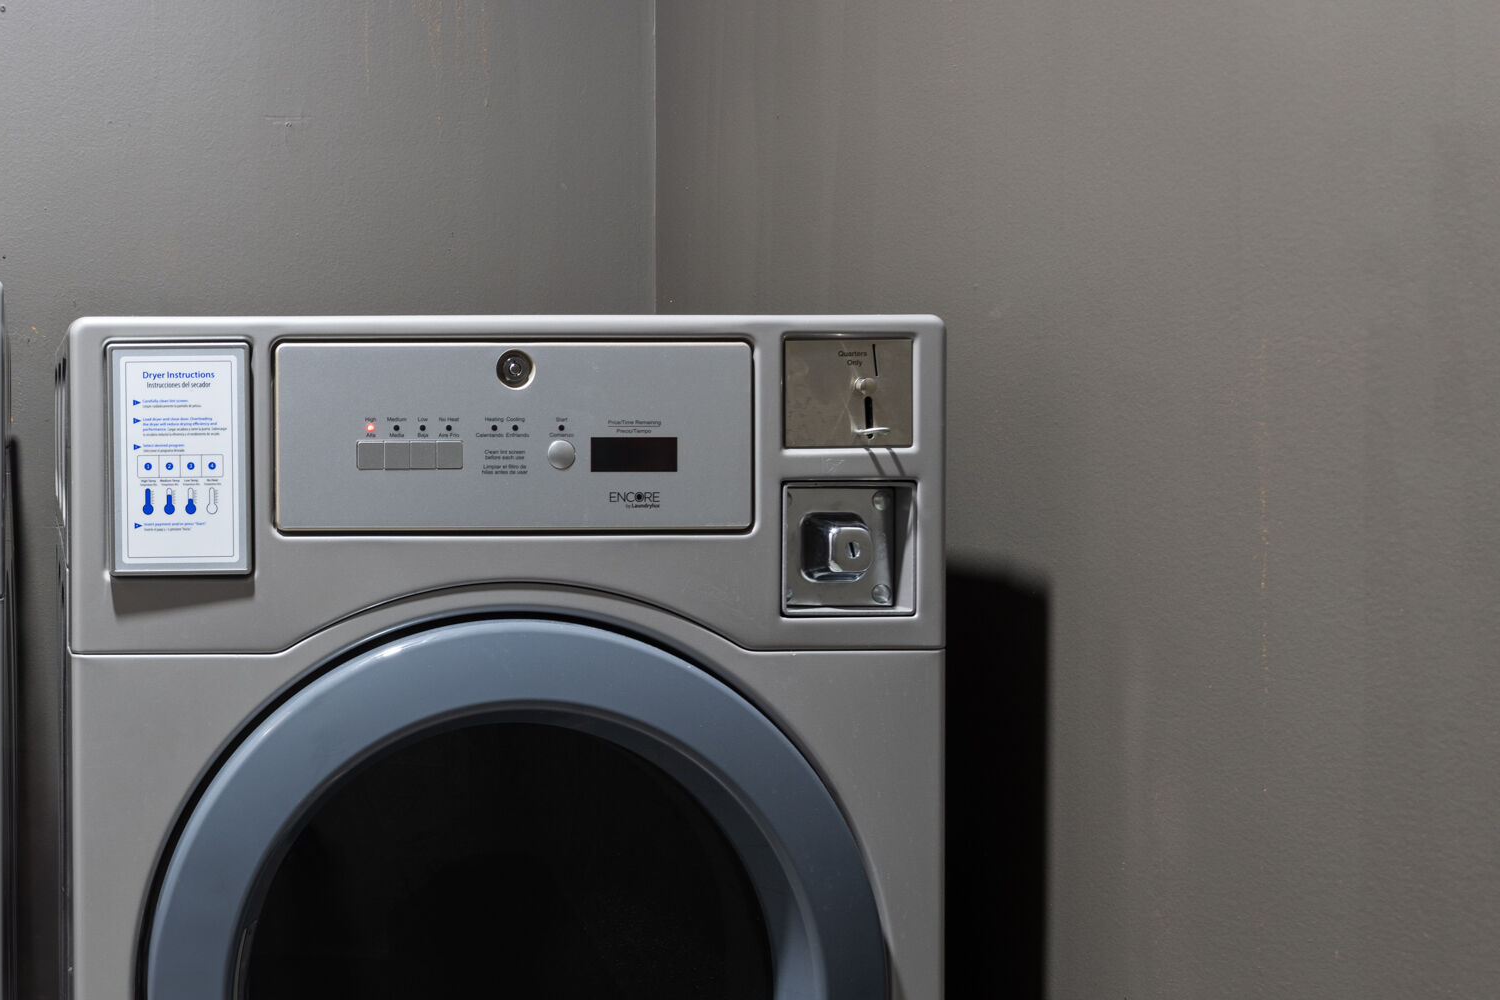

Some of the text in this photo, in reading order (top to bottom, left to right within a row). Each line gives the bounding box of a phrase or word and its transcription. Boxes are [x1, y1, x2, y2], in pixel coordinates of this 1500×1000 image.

[846, 359, 862, 367] Only
[142, 370, 215, 380] Dryer Instructions
[146, 381, 181, 389] Instrucciones
[181, 381, 190, 389] del
[609, 491, 660, 502] ENCORE
